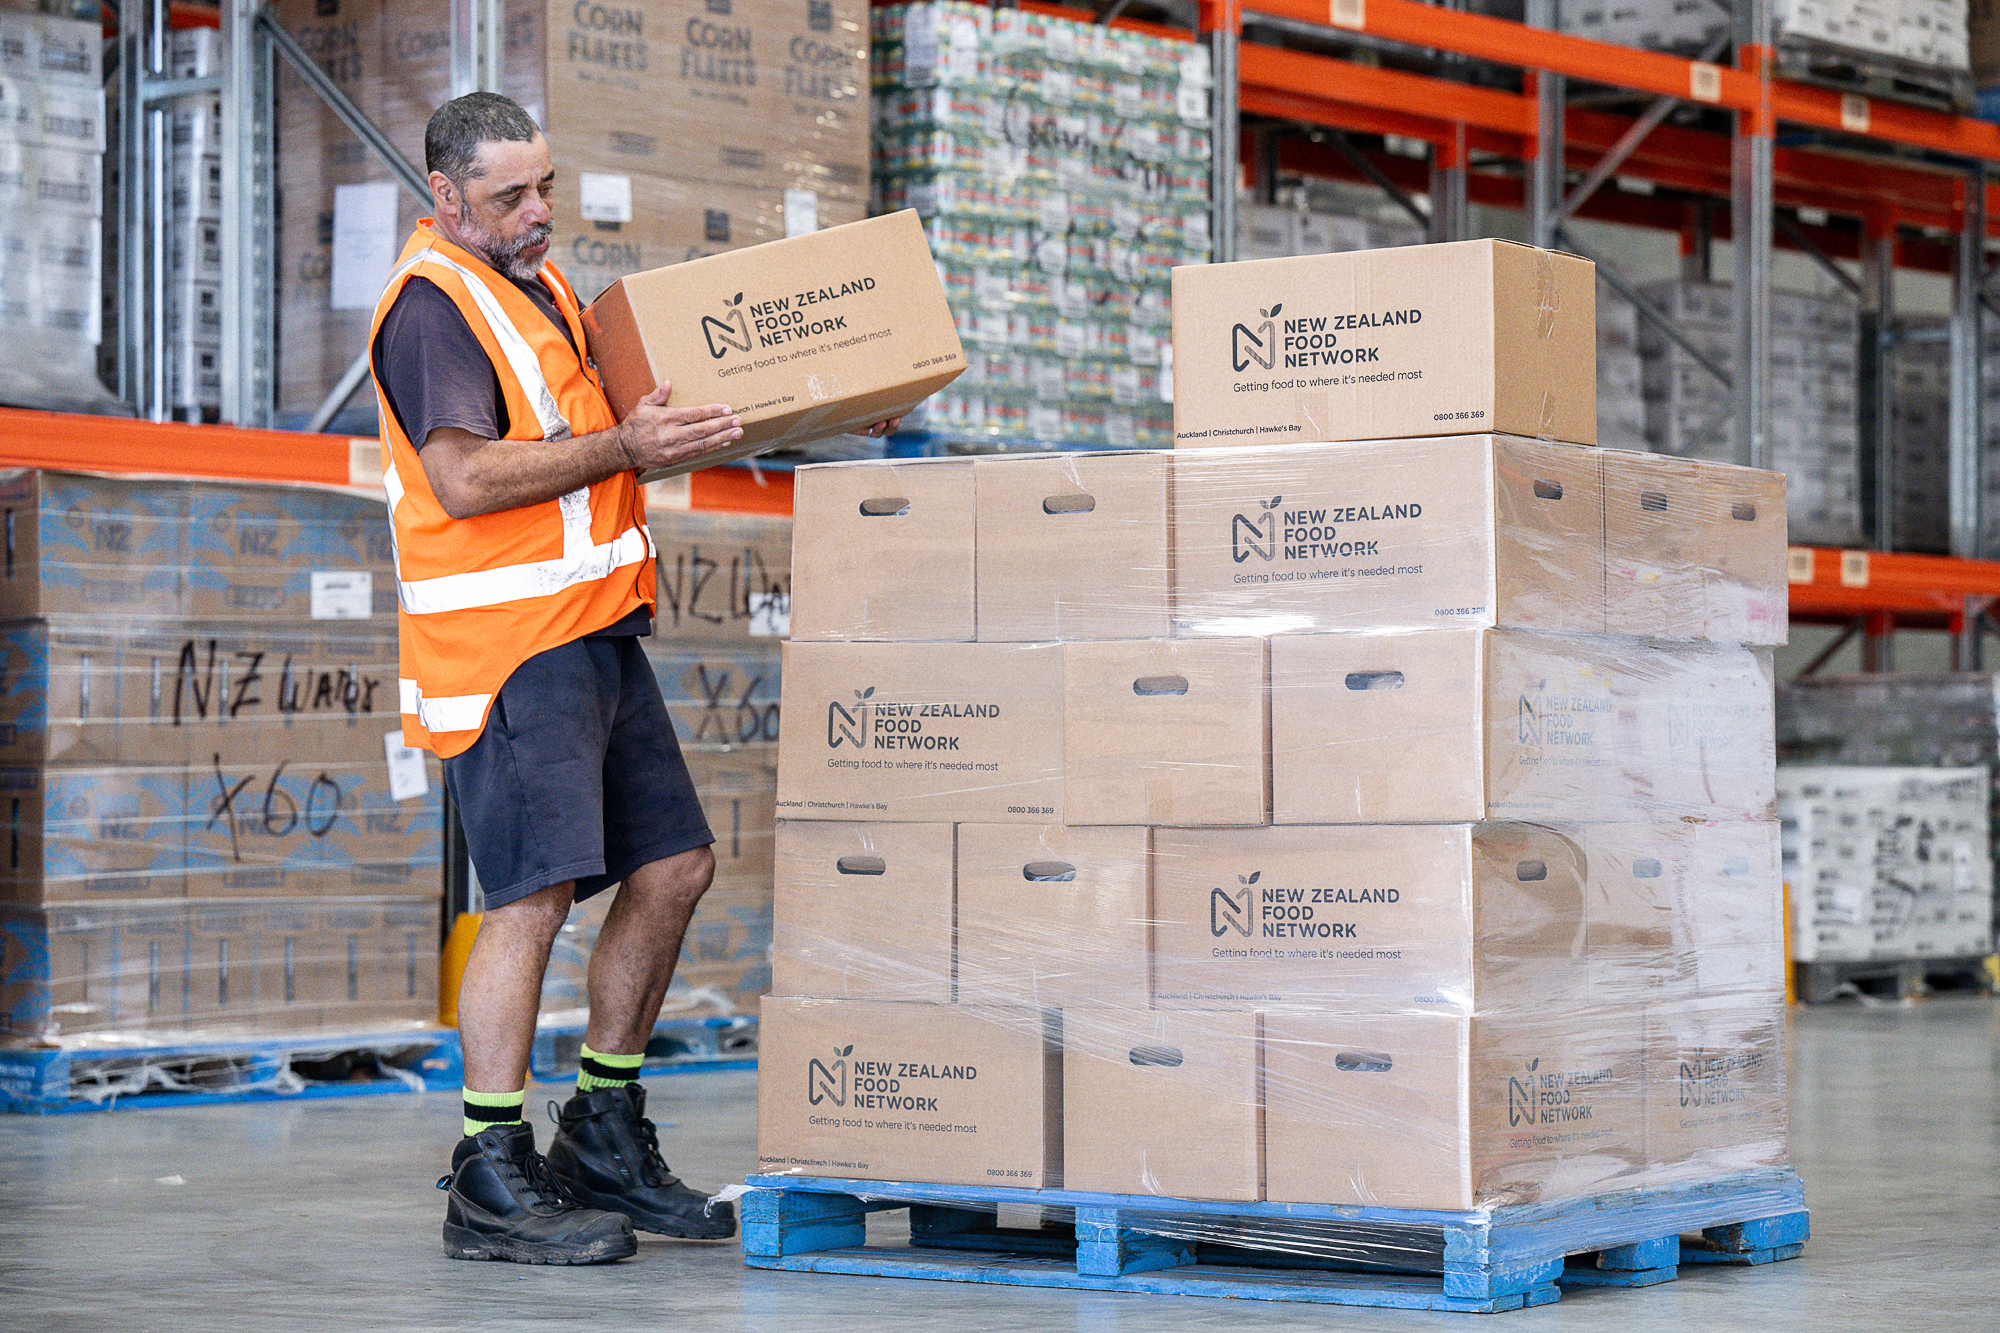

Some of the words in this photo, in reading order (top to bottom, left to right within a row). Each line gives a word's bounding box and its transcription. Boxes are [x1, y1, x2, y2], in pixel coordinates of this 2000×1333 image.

[750, 296, 790, 318] NEW
[795, 277, 877, 308] ZEALAND
[754, 310, 804, 333] FOOD
[1283, 317, 1328, 334] NEW
[1334, 309, 1422, 330] ZEALAND
[759, 315, 848, 348] NETWORK
[1284, 333, 1337, 351] FOOD
[717, 362, 753, 379] Getting
[753, 355, 776, 370] food
[776, 353, 788, 364] to
[789, 346, 818, 360] where
[818, 342, 832, 354] it's
[832, 333, 868, 352] needed
[868, 327, 892, 342] most
[912, 359, 931, 370] 0800
[931, 356, 945, 367] 366
[944, 353, 957, 363] 369
[1284, 347, 1380, 368] NETWORK
[1232, 381, 1270, 393] Getting
[1271, 379, 1294, 390] food
[1295, 378, 1307, 388] to
[1309, 376, 1340, 387] where
[1341, 374, 1356, 385] it's
[1358, 371, 1395, 384] needed
[1397, 369, 1423, 381] most
[754, 398, 782, 410] Hawke's
[782, 395, 795, 403] Bay
[1433, 412, 1454, 422] 0800
[1455, 411, 1469, 420] 366
[1470, 410, 1485, 419] 369
[1176, 429, 1208, 439] Auckland
[1212, 427, 1255, 438] Christchurch
[1259, 425, 1288, 435] Hawke's
[1288, 423, 1302, 433] Bay
[1283, 509, 1327, 526] NEW
[1333, 503, 1422, 523] ZEALAND
[1283, 526, 1336, 543] FOOD
[1284, 540, 1379, 560] NETWORK
[1233, 573, 1270, 585] Getting
[1271, 570, 1294, 582] food
[1295, 570, 1307, 580] to
[1309, 568, 1340, 579] where
[1341, 567, 1356, 578] it's
[1357, 564, 1395, 577] needed
[1397, 565, 1423, 575] most
[1455, 607, 1470, 615] 366
[1471, 606, 1486, 614] 369
[875, 702, 914, 717] NEW
[919, 702, 1001, 719] ZEALAND
[1546, 696, 1567, 712] NEW
[1570, 697, 1612, 714] ZEALAND
[874, 719, 922, 733] FOOD
[1546, 713, 1573, 729] FOOD
[874, 735, 960, 751] NETWORK
[1546, 731, 1593, 746] NETWORK
[827, 758, 860, 770] Getting
[861, 758, 882, 769] food
[883, 760, 894, 769] to
[895, 760, 923, 769] where
[924, 760, 938, 770] it's
[939, 760, 974, 771] needed
[975, 762, 999, 771] most
[775, 800, 803, 808] Auckland
[807, 801, 845, 809] Christchurch
[849, 801, 875, 810] Hawke's
[876, 802, 888, 811] Bay
[1007, 806, 1026, 814] 0800
[1027, 806, 1040, 814] 366
[1041, 806, 1054, 815] 369
[1262, 888, 1304, 903] NEW
[1311, 888, 1400, 904] ZEALAND
[1262, 905, 1314, 920] FOOD
[1262, 923, 1357, 938] NETWORK
[1212, 947, 1248, 960] Getting
[1249, 948, 1273, 959] food
[1274, 949, 1285, 959] to
[1287, 948, 1318, 959] where
[1320, 949, 1334, 960] it's
[1336, 949, 1374, 960] needed
[1376, 949, 1402, 959] most
[854, 1061, 892, 1076] NEW
[898, 1063, 977, 1080] ZEALAND
[1540, 1073, 1564, 1089] NEW
[1567, 1068, 1613, 1086] ZEALAND
[854, 1078, 900, 1093] FOOD
[854, 1094, 938, 1112] NETWORK
[1540, 1090, 1571, 1106] FOOD
[1540, 1105, 1592, 1124] NETWORK
[809, 1115, 840, 1128] Getting
[842, 1117, 862, 1127] food
[864, 1118, 874, 1128] to
[876, 1120, 902, 1130] where
[904, 1121, 917, 1131] it's
[918, 1122, 952, 1132] needed
[954, 1124, 977, 1134] most
[759, 1155, 786, 1165] Auckland
[790, 1157, 828, 1167] Christchurch
[831, 1159, 857, 1168] Hawke's
[857, 1161, 870, 1170] Bay
[986, 1169, 1005, 1178] 0800
[1005, 1170, 1019, 1178] 366
[1020, 1170, 1033, 1178] 369
